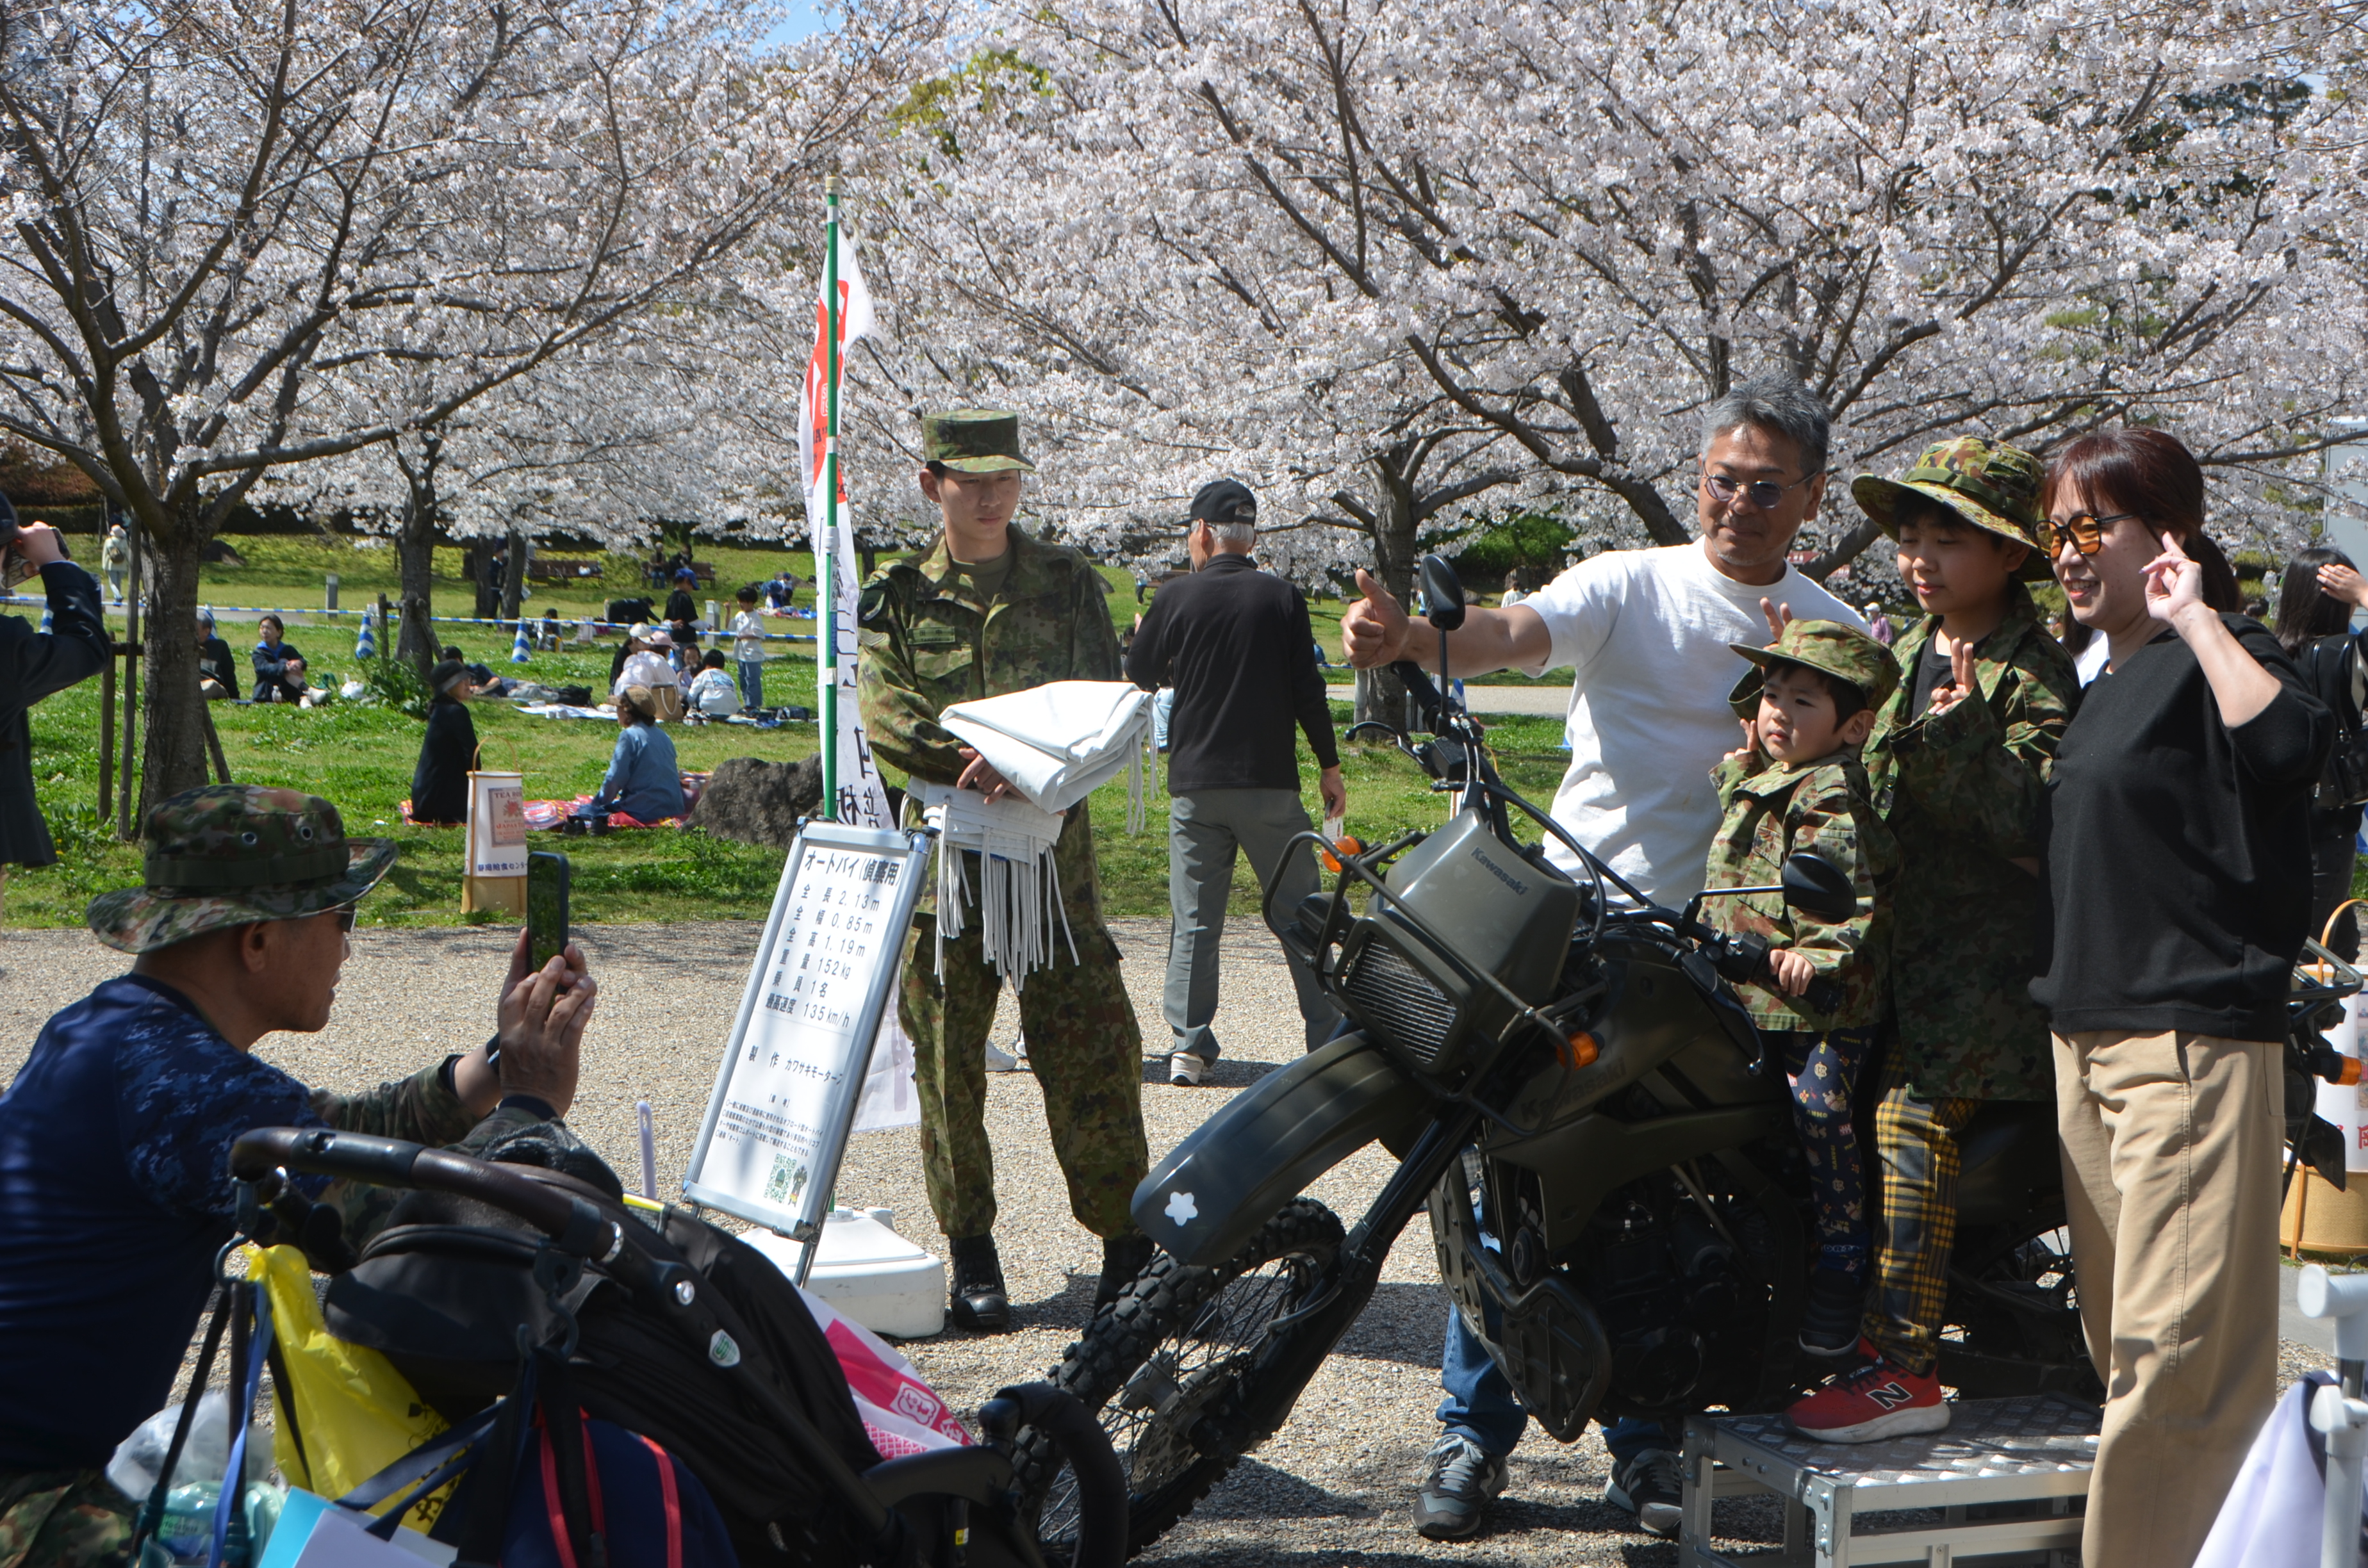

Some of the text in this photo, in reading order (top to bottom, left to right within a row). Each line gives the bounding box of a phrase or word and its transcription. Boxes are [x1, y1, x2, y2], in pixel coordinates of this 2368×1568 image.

[1471, 846, 1528, 896] Kawasaki
[765, 993, 797, 1015] 最高速度
[1865, 1382, 1913, 1410] N
